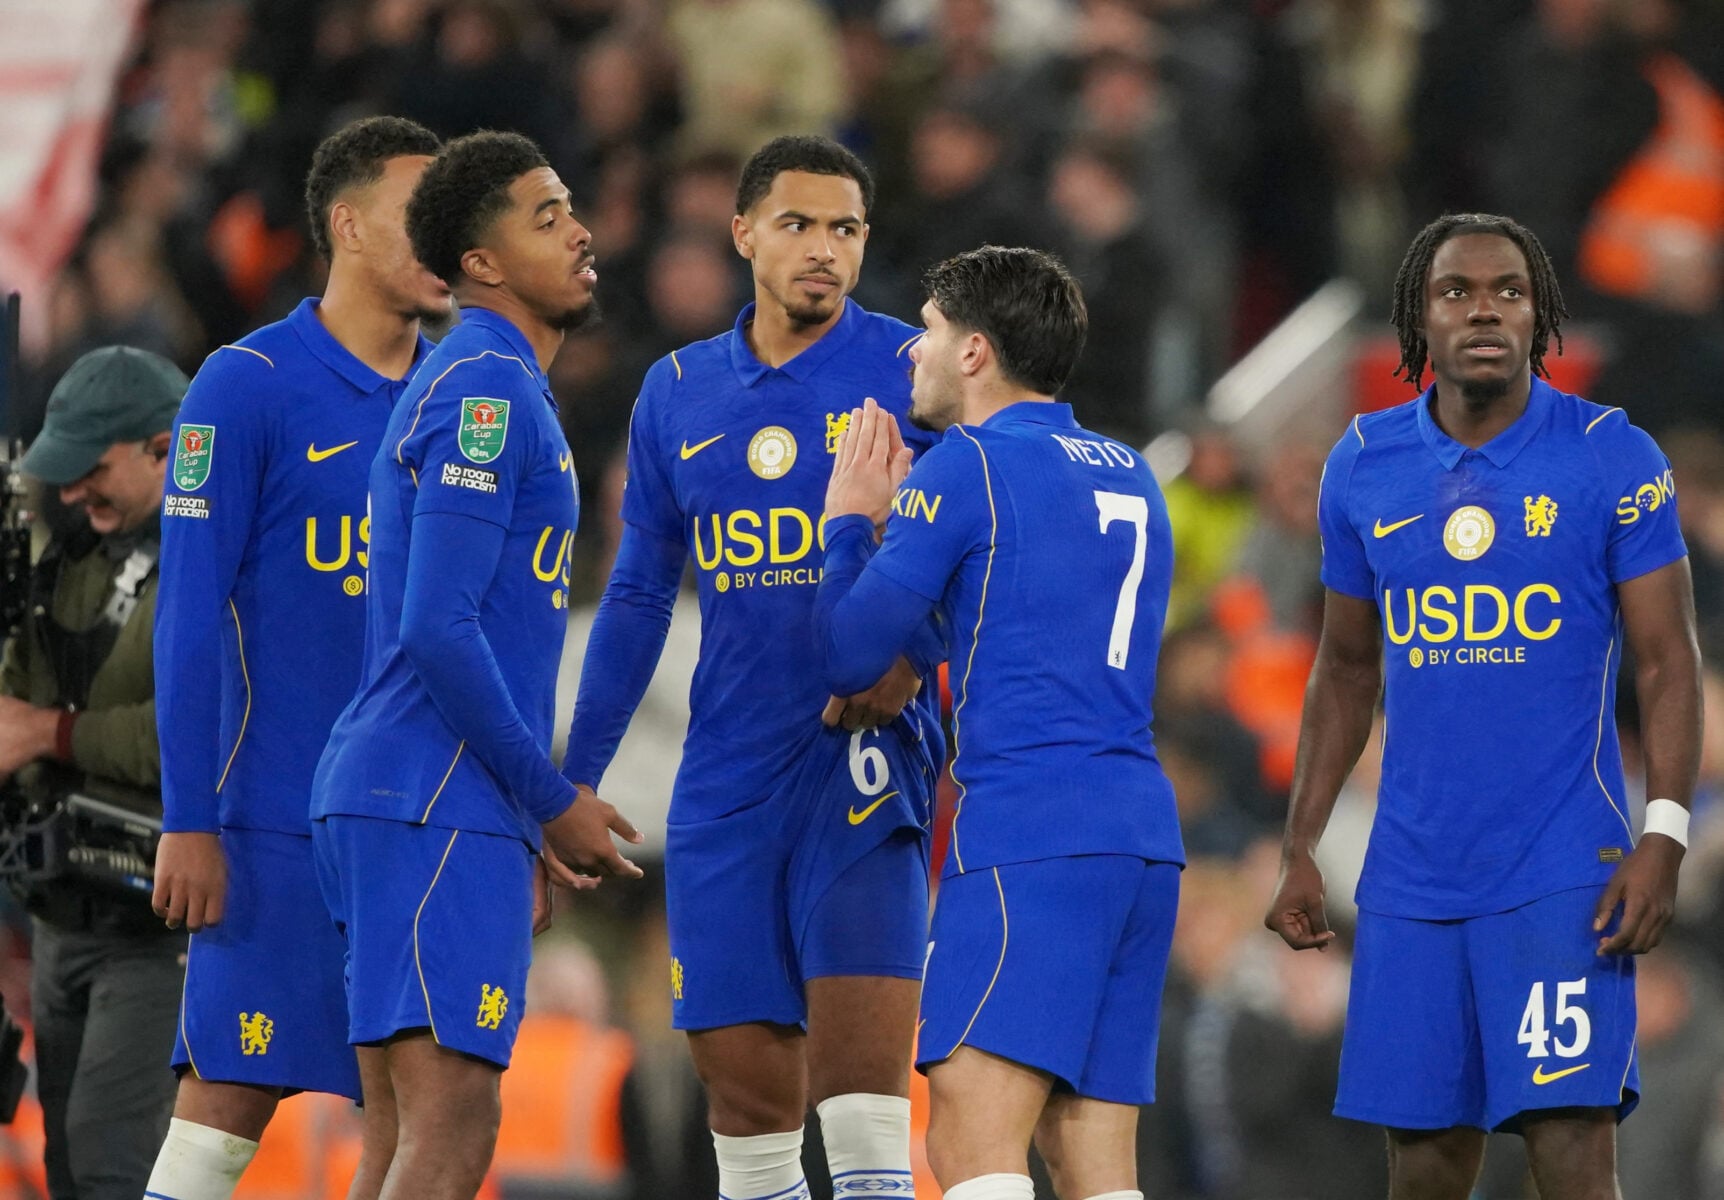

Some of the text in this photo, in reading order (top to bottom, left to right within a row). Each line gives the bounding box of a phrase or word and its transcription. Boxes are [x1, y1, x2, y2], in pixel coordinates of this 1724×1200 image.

[464, 422, 503, 431] Carabao
[473, 430, 491, 439] Cup
[178, 449, 208, 460] Carabao
[1050, 433, 1135, 469] NETO
[184, 459, 198, 467] Cup
[762, 466, 782, 475] FIFA
[444, 463, 495, 483] No room
[441, 473, 497, 494] for racism
[165, 494, 205, 509] No room
[891, 488, 942, 523] KIN
[175, 506, 209, 519] racism
[694, 507, 825, 570] USD
[735, 572, 756, 588] BY
[1093, 490, 1149, 671] 7
[1385, 583, 1562, 645] USDC
[1429, 647, 1526, 665] BY CIRCLE
[849, 726, 889, 796] 6
[1517, 977, 1591, 1059] 45
